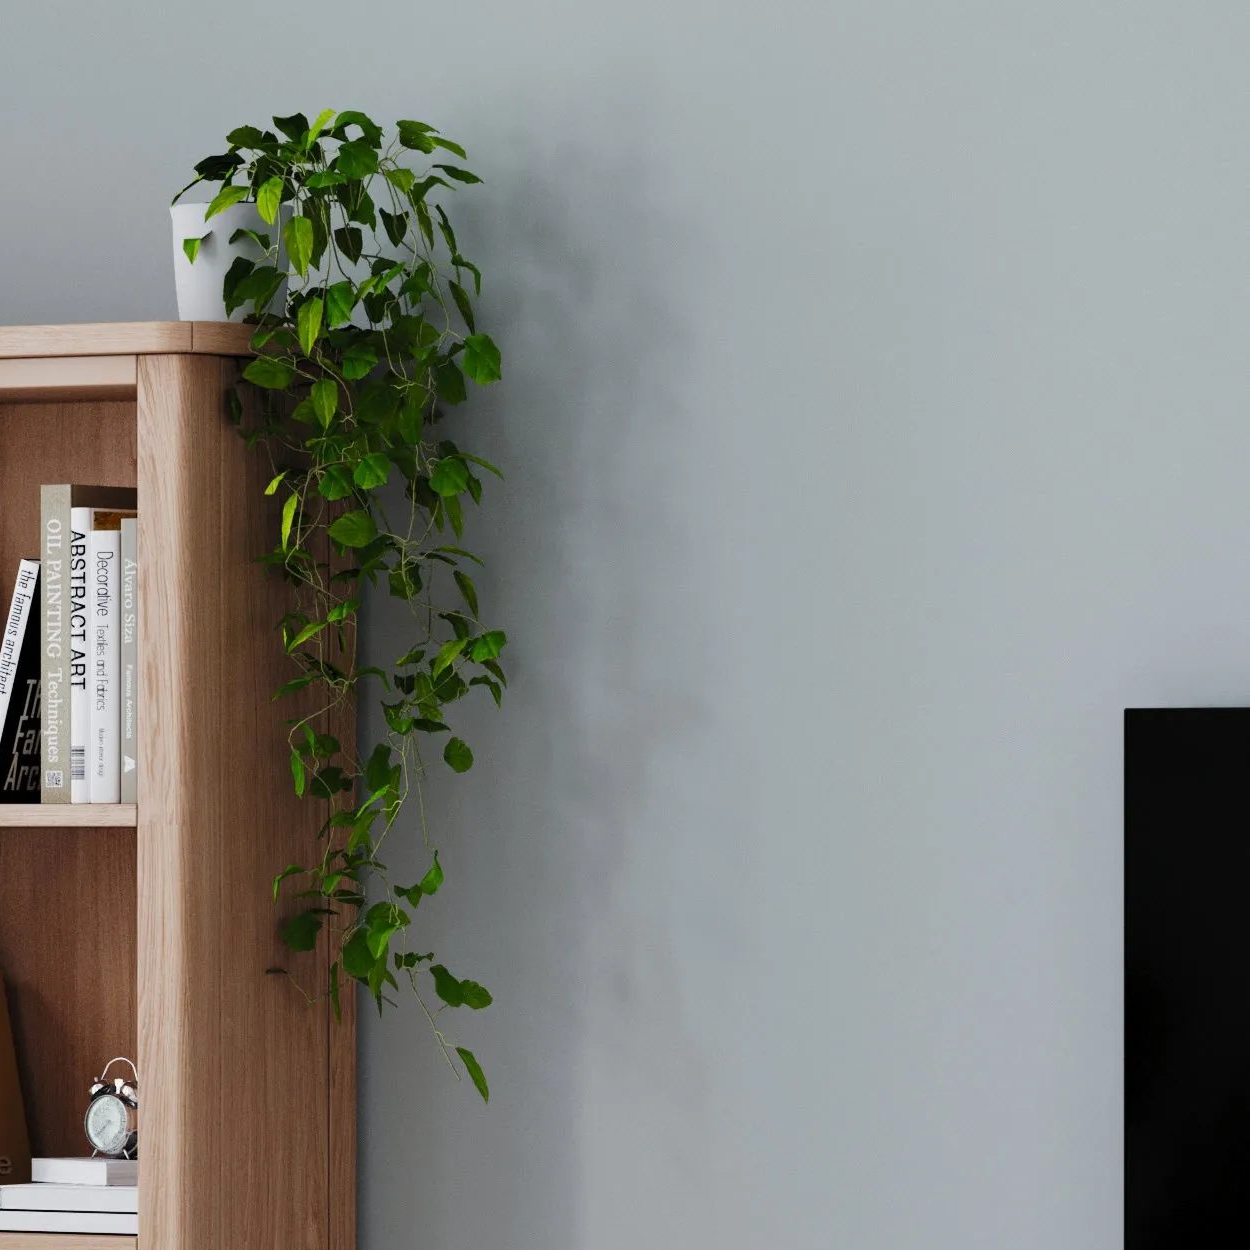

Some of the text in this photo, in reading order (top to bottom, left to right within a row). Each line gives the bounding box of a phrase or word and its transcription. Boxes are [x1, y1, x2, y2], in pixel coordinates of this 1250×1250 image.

[8, 591, 31, 636] famous
[21, 569, 36, 589] the
[71, 531, 86, 690] ABSTRACT ART
[124, 557, 137, 644] Álvaro Siza
[43, 519, 63, 763] OIL PAINTING Techniques
[96, 551, 114, 711] Decorative Textiles and Fabrics
[126, 664, 134, 697] Famous
